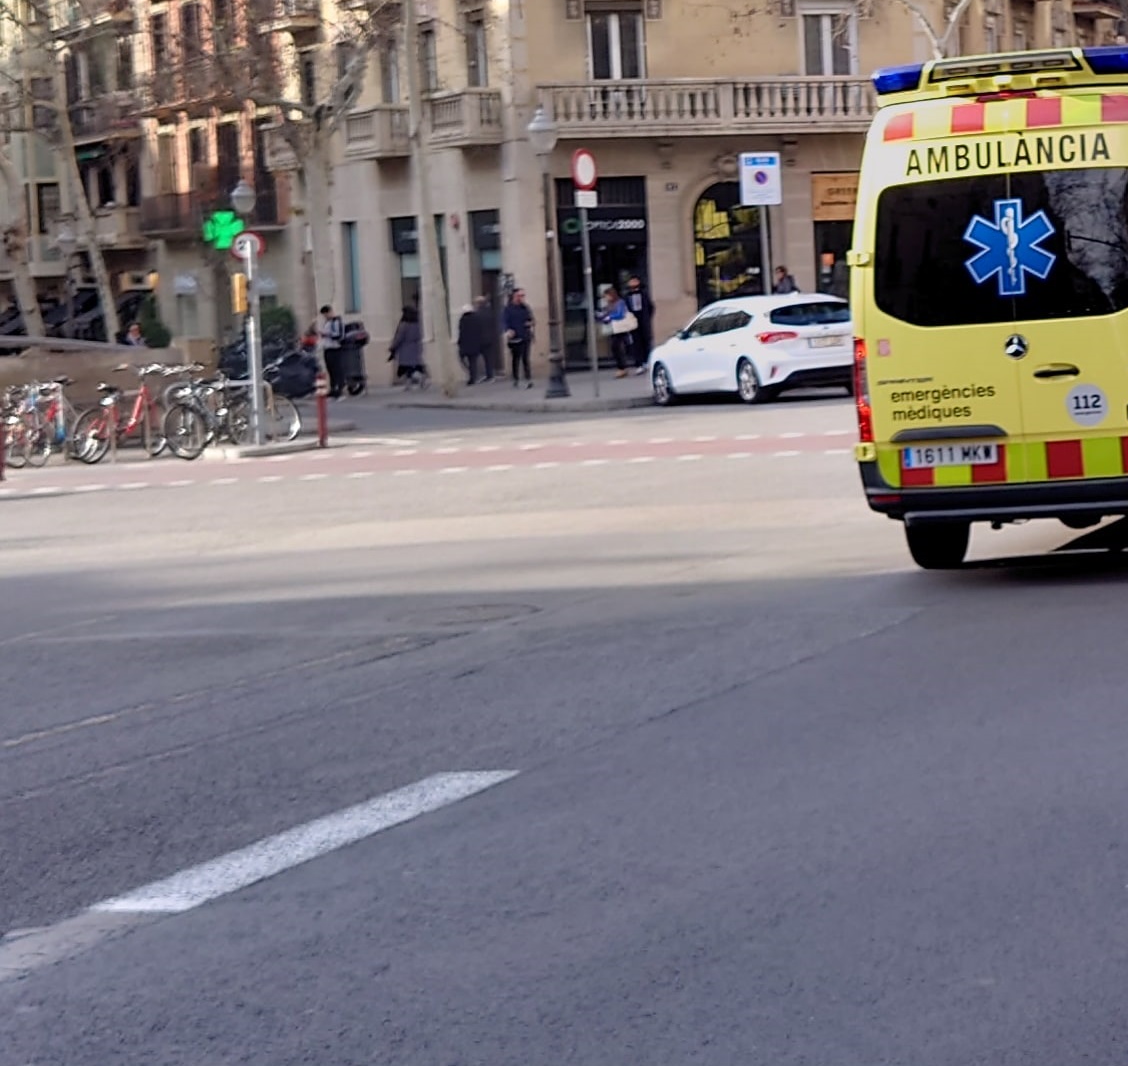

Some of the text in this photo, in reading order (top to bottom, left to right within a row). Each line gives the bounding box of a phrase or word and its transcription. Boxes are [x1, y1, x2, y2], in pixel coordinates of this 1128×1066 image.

[906, 132, 1110, 176] AMBULÀNCIA
[890, 384, 996, 404] emergències
[1073, 394, 1101, 410] 112
[892, 405, 972, 422] mèdiques
[915, 447, 955, 465] 1611
